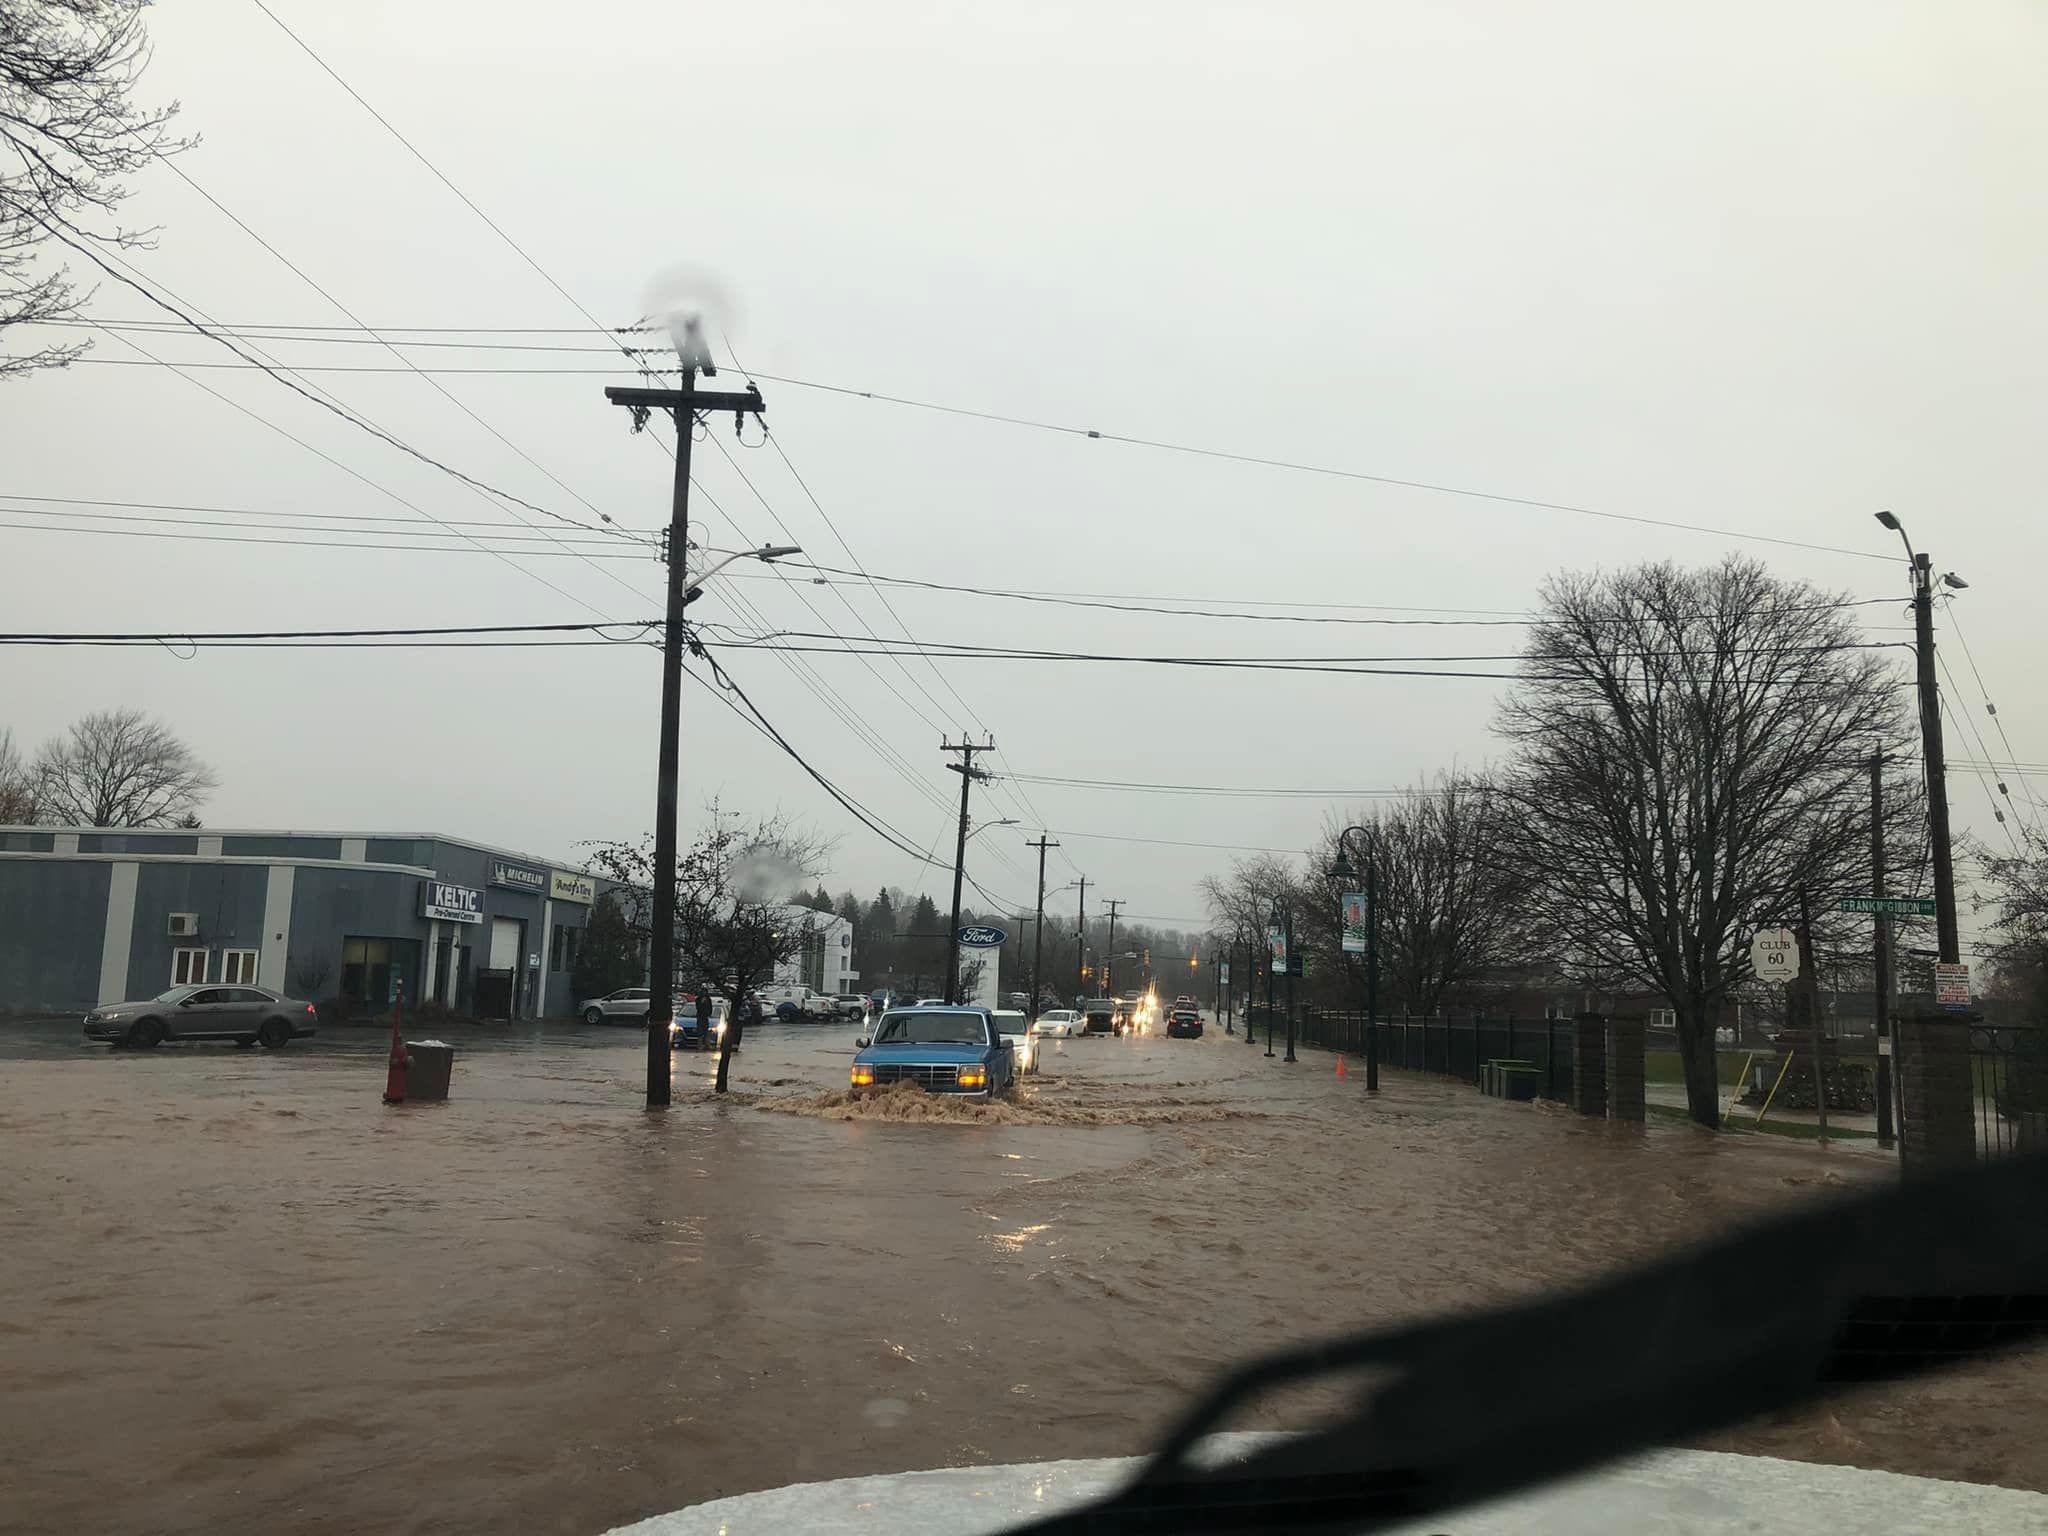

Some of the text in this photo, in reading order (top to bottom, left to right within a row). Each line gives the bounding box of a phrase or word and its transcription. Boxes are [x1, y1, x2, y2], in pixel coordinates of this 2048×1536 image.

[506, 867, 545, 886] MICHELIN
[435, 885, 477, 911] KELTIC
[1842, 900, 1876, 912] FRANK
[963, 928, 995, 943] Ford
[1760, 941, 1791, 950] CLUB
[1768, 952, 1785, 965] 60
